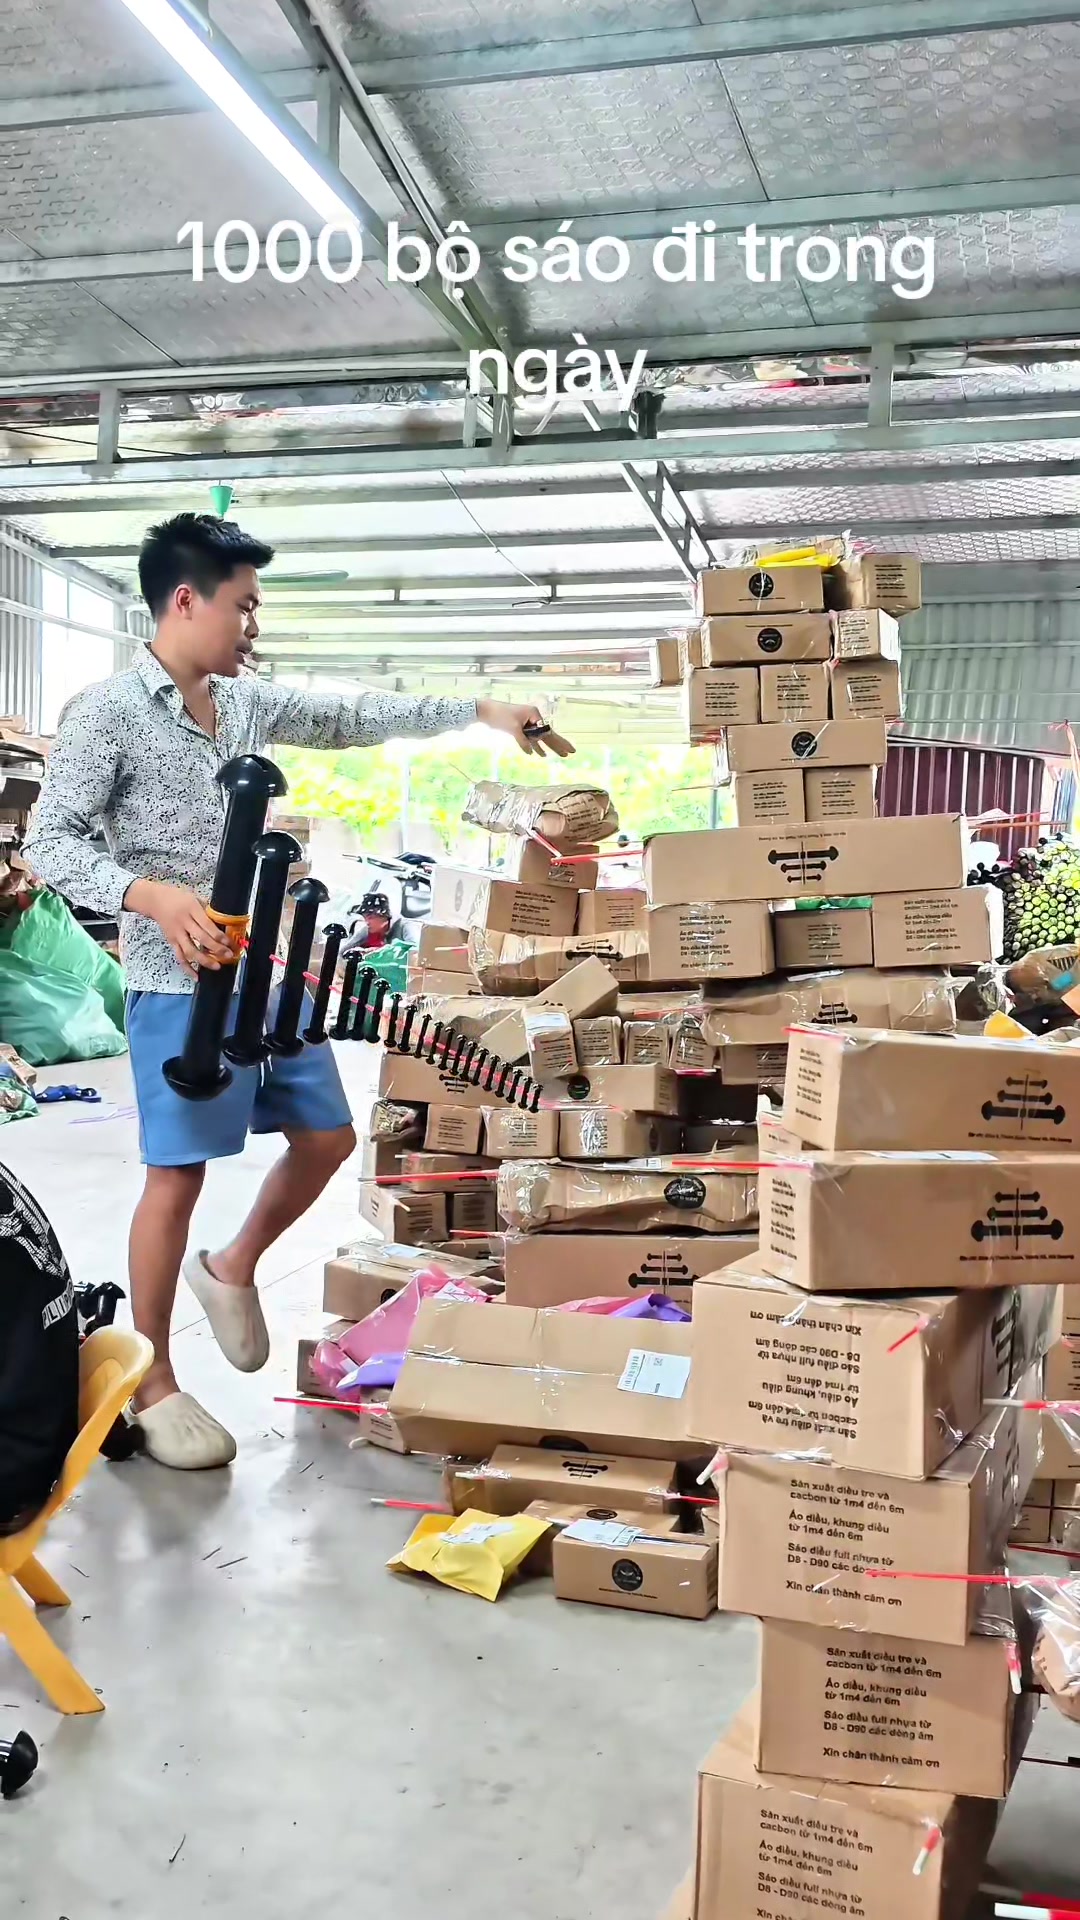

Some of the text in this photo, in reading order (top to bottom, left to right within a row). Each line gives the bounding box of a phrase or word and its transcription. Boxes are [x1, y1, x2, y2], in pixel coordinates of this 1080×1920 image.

[845, 1325, 861, 1336] Xin
[799, 1357, 814, 1366] full
[787, 1375, 801, 1384] 6m
[825, 1381, 844, 1391] 1m4
[786, 1386, 815, 1398] khung
[748, 1401, 763, 1410] 6m
[776, 1417, 788, 1426] tre
[822, 1412, 857, 1425] cacbon
[861, 1490, 875, 1498] tre
[790, 1491, 826, 1503] cacbon
[844, 1499, 864, 1508] 1m4
[889, 1505, 904, 1514] 6m
[833, 1517, 864, 1531] khung
[804, 1525, 823, 1535] 1m4
[848, 1532, 863, 1541] 6m
[834, 1550, 850, 1559] full
[786, 1581, 802, 1590] Xin
[898, 1655, 912, 1663] tre
[826, 1660, 863, 1670] cacbon
[881, 1666, 902, 1674] 1m4
[926, 1669, 941, 1678] 6m
[870, 1684, 901, 1696] khung
[840, 1693, 860, 1701] 1m4
[885, 1697, 900, 1706] 6m
[872, 1715, 887, 1723] full
[823, 1747, 839, 1757] Xin
[831, 1825, 843, 1834] tre
[760, 1822, 796, 1835] cacbon
[814, 1833, 833, 1843] 1m4
[858, 1842, 873, 1853] 6m
[802, 1850, 833, 1867] khung
[773, 1856, 793, 1866] 1m4
[817, 1866, 832, 1876] 6m
[803, 1882, 819, 1893] full
[757, 1908, 772, 1919] Xin
